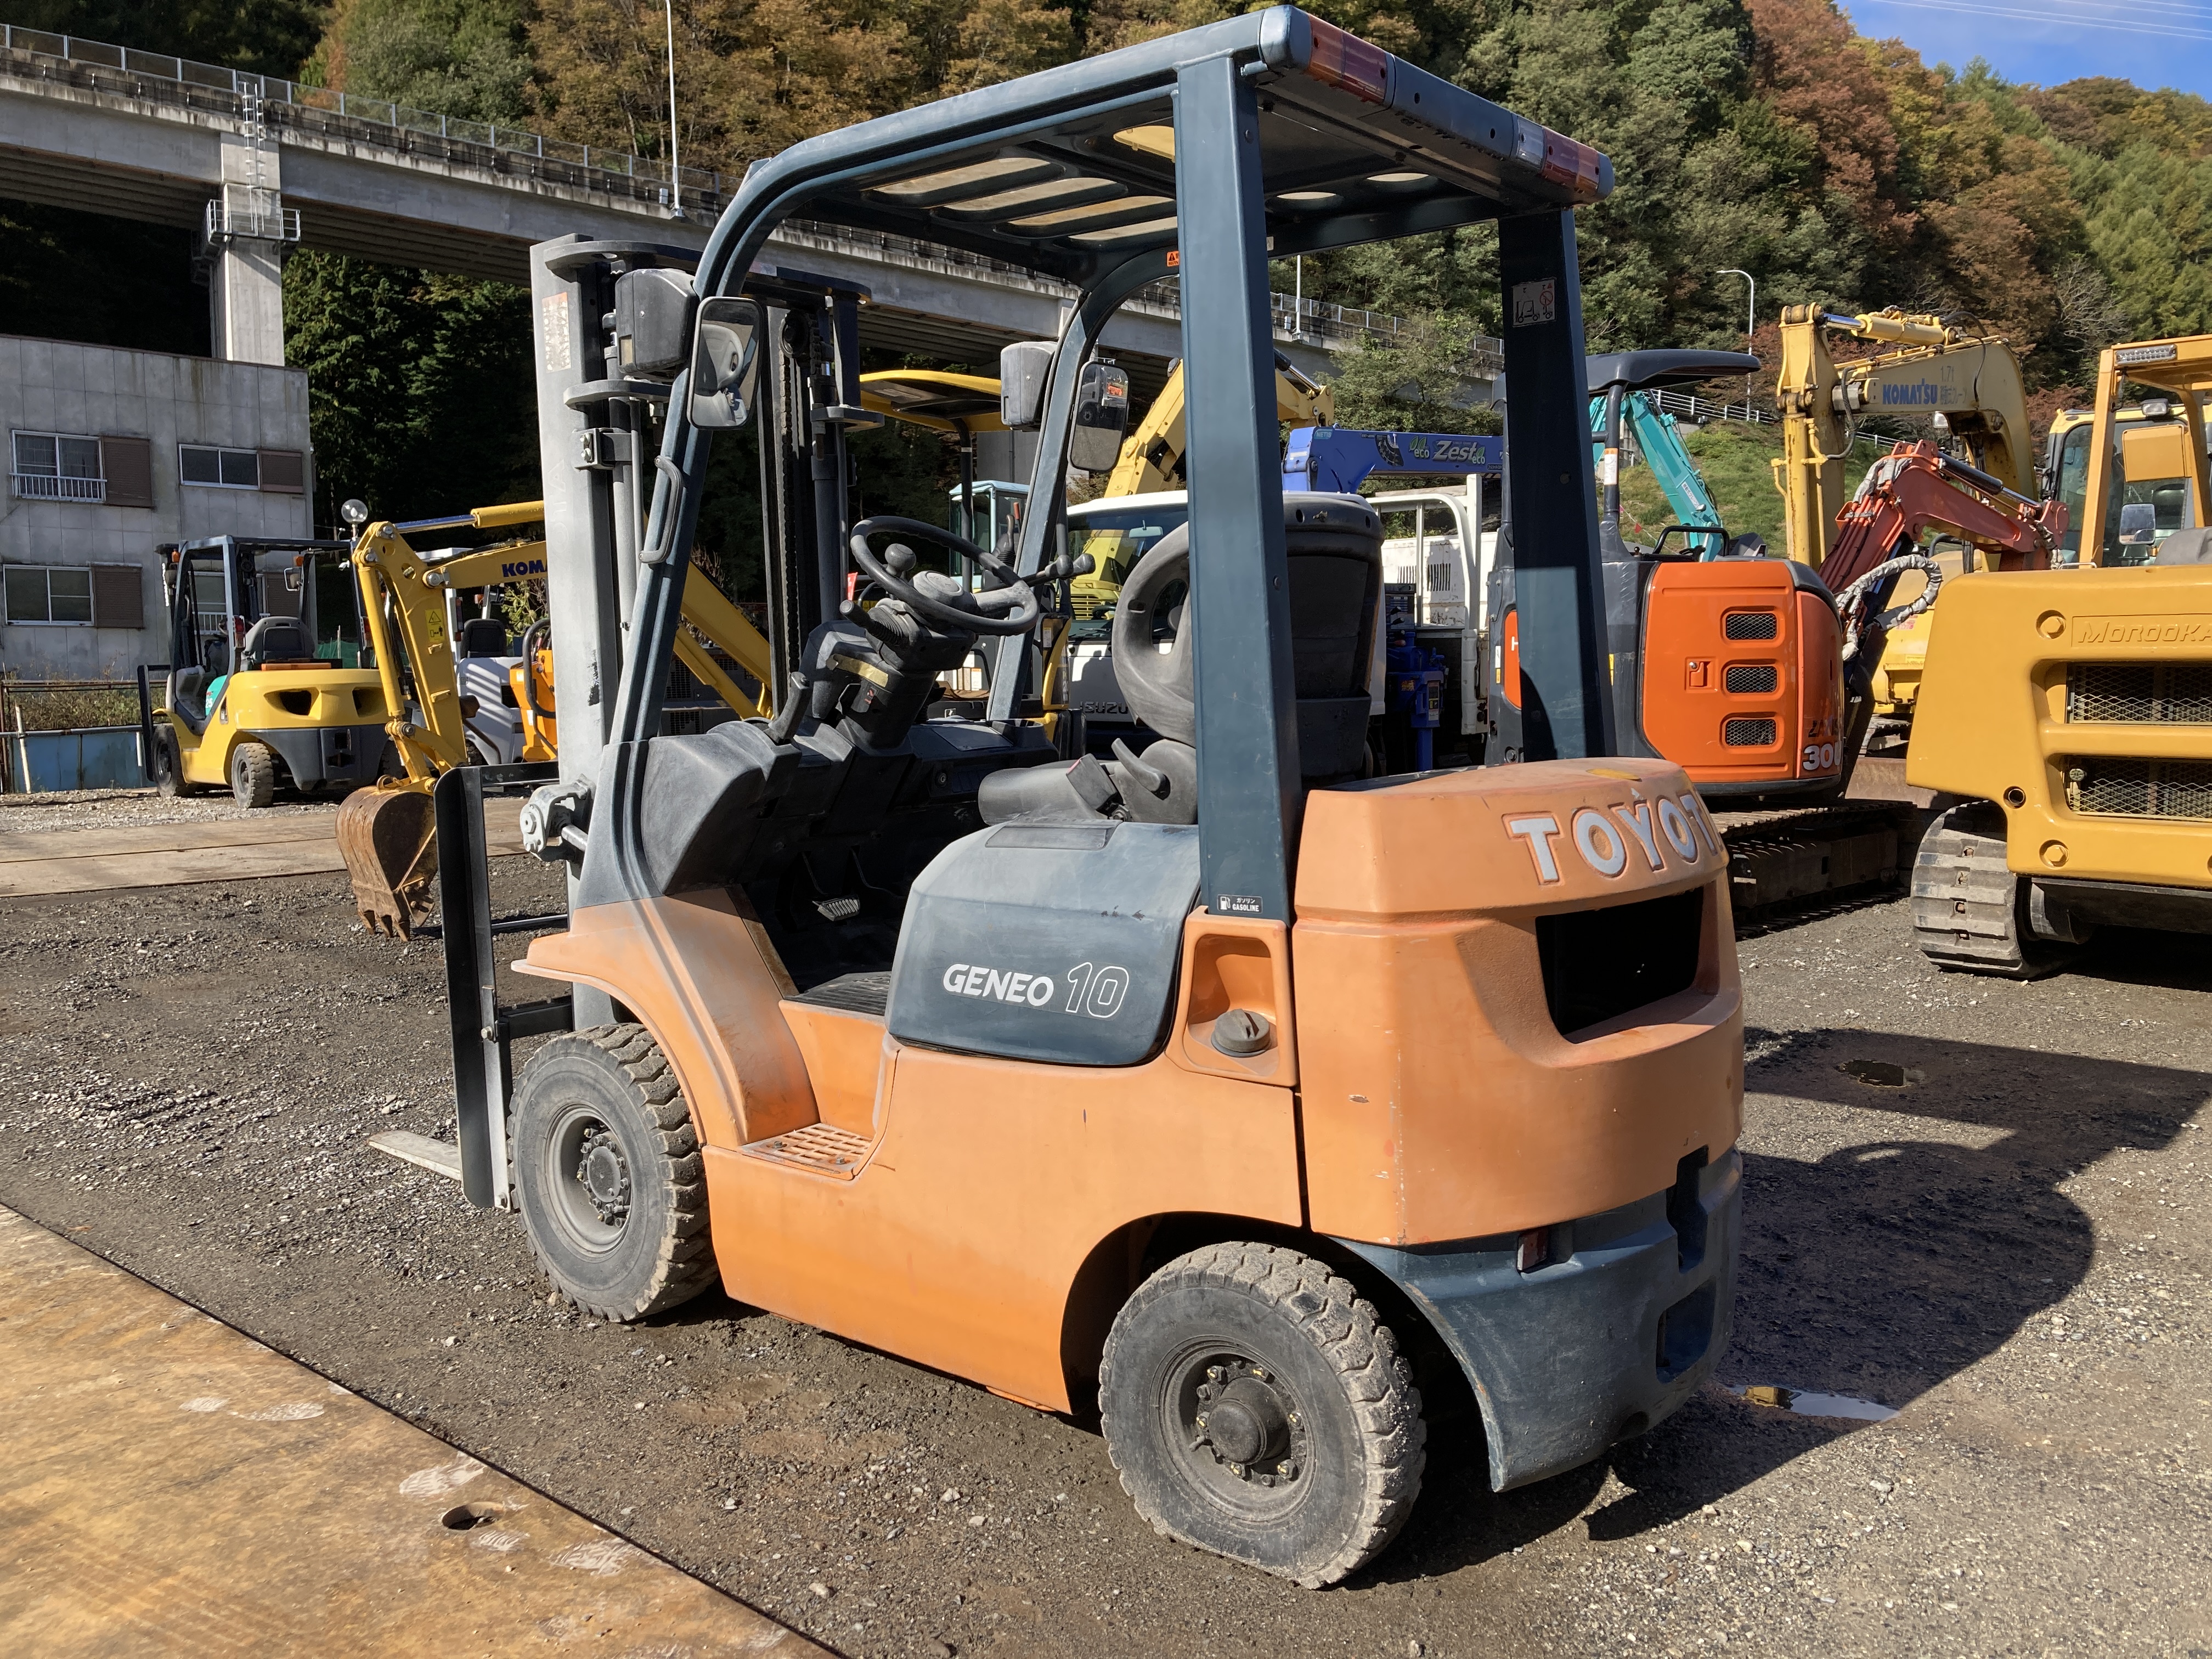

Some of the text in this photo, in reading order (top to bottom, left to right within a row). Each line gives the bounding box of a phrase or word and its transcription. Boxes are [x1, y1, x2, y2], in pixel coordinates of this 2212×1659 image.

[1882, 378, 1938, 405] KOMATSU
[1414, 448, 1430, 458] eco
[1432, 440, 1477, 461] Zest
[1472, 456, 1486, 464] eco
[501, 559, 548, 578] KOM
[1080, 701, 1128, 714] ISUZU
[1504, 790, 1725, 884] TOYOT
[1232, 903, 1260, 912] GASOLINE
[943, 962, 1130, 1018] GENEO 10
